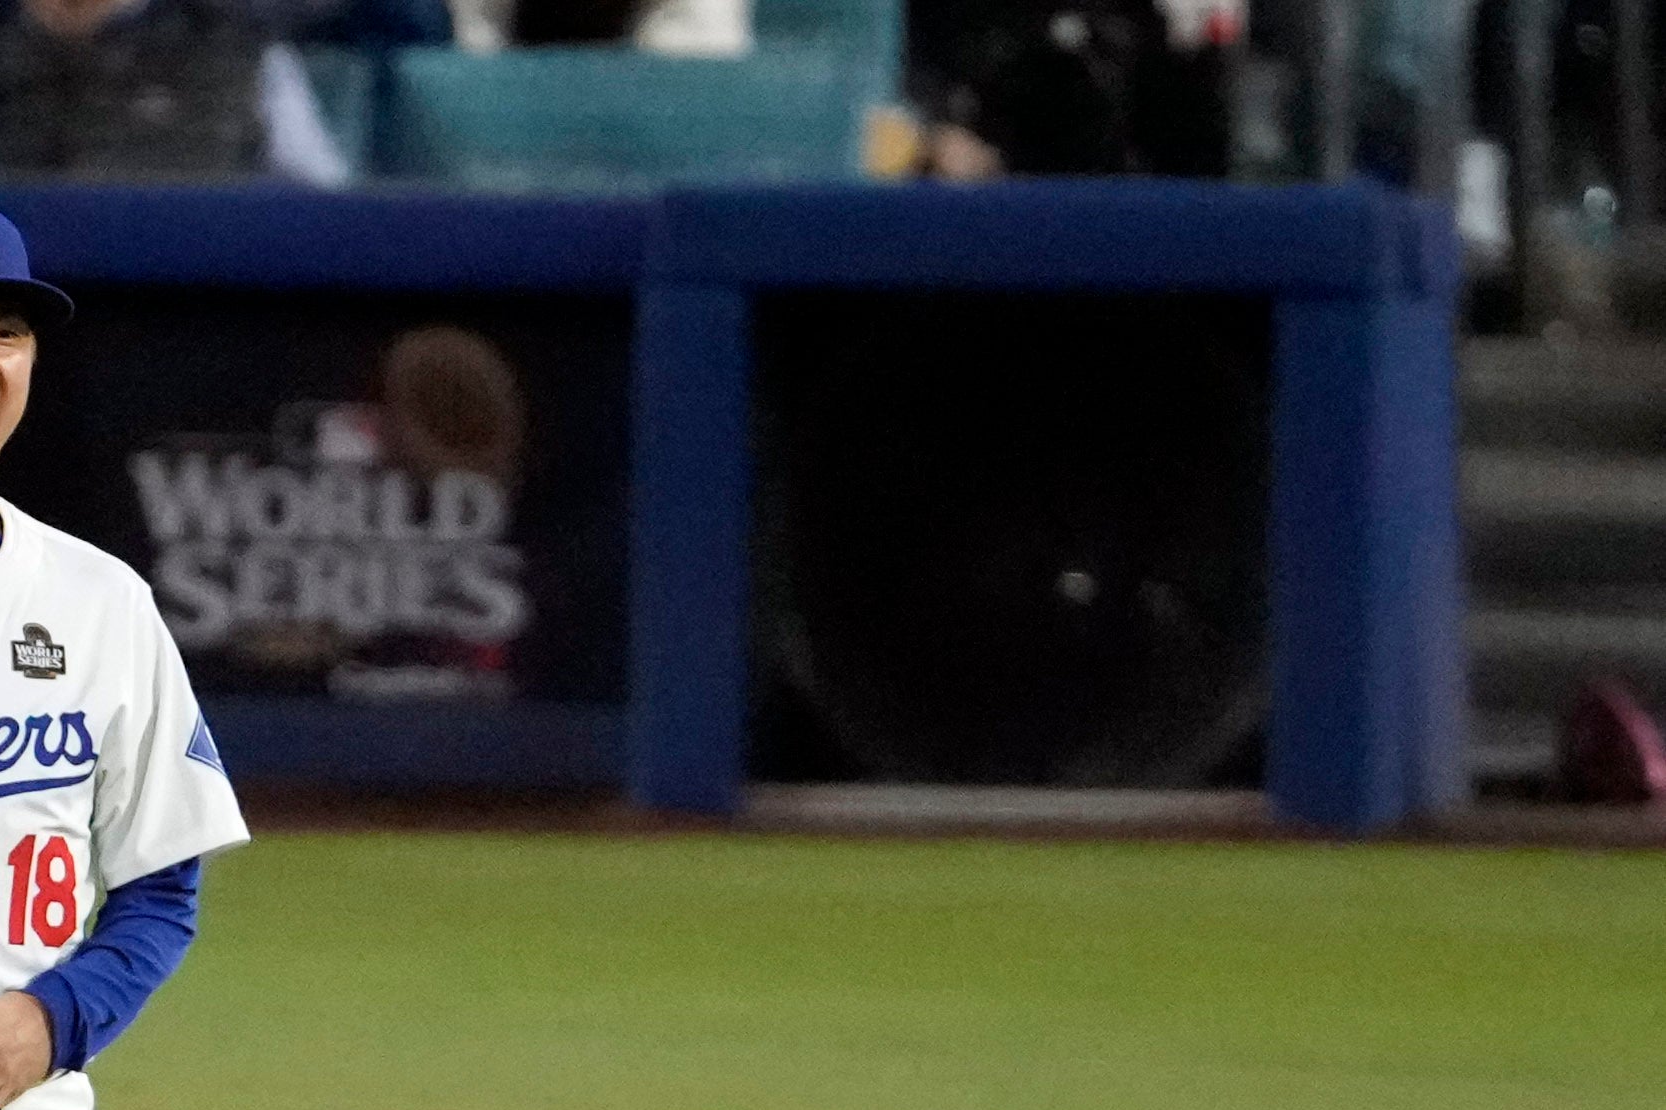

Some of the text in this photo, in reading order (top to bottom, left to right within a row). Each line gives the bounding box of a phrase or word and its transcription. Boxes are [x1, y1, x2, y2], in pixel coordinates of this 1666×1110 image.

[129, 448, 508, 541] WORLD
[154, 535, 530, 645] SERIES
[14, 643, 63, 659] WORLD
[16, 654, 63, 669] SERIES
[7, 834, 77, 948] 18
